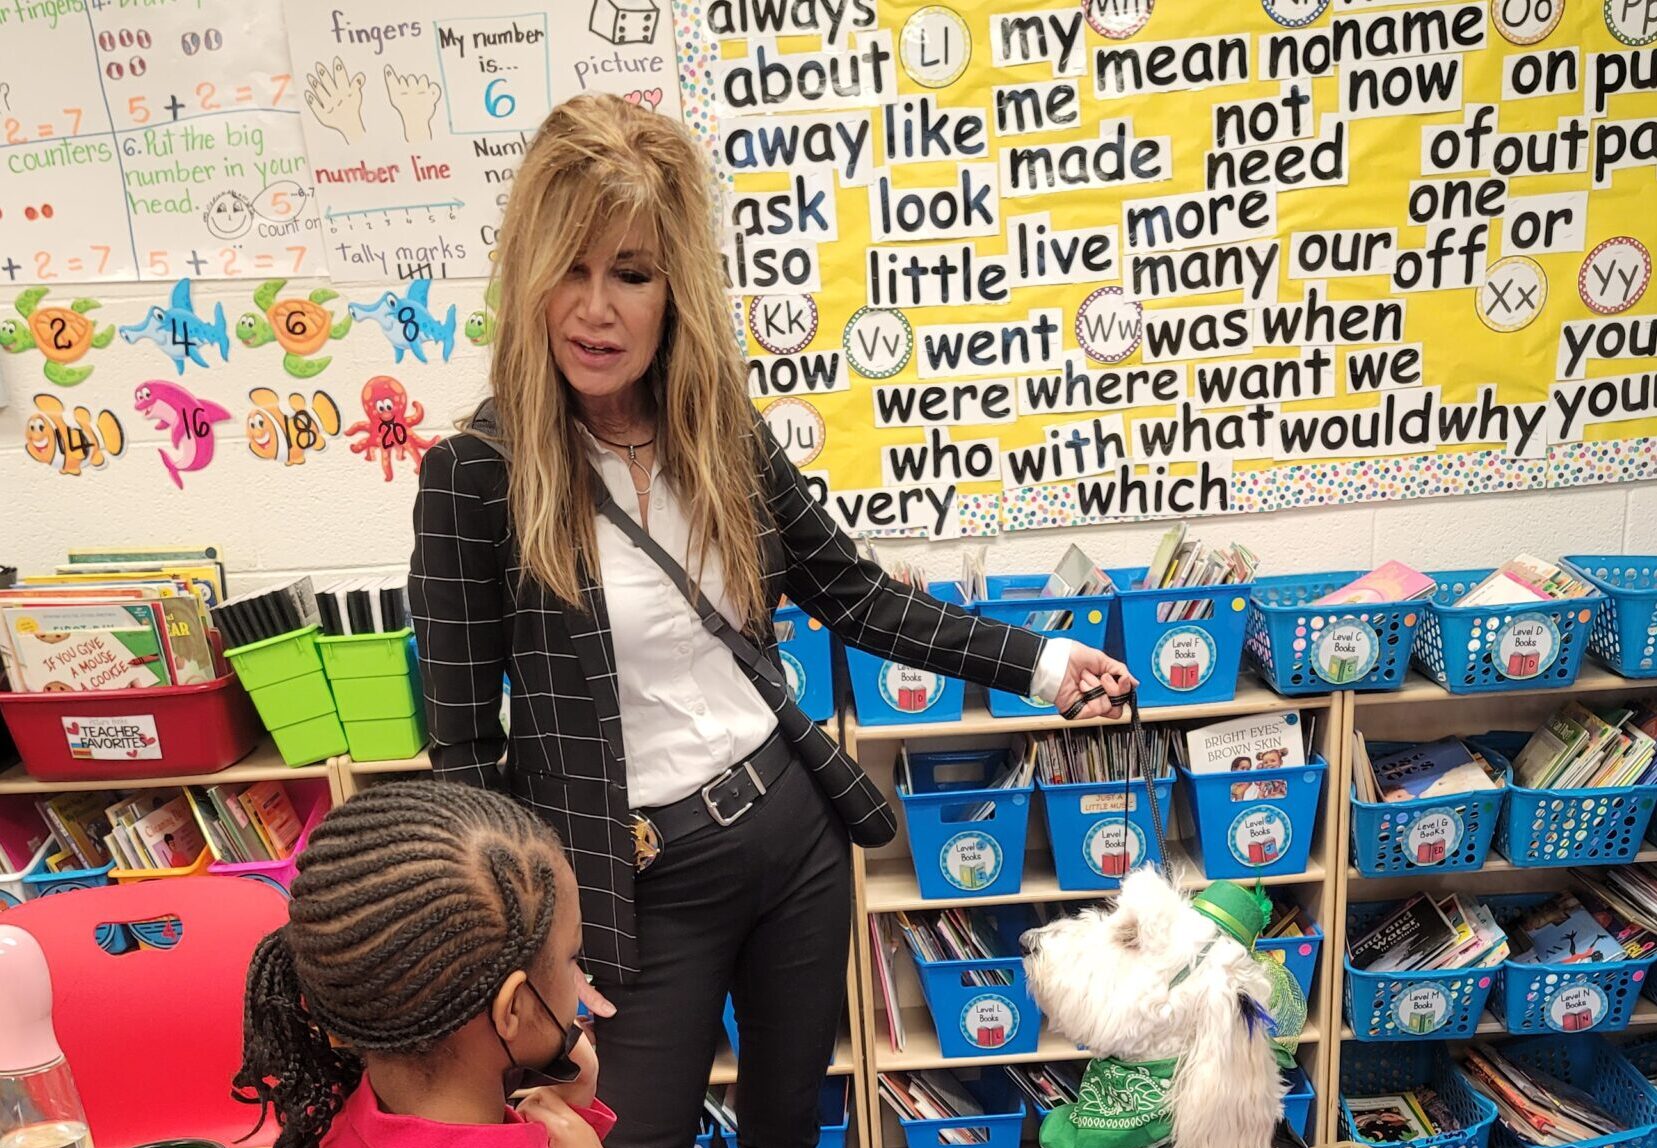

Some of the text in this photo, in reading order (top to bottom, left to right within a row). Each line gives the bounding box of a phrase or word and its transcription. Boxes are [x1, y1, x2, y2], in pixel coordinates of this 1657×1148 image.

[332, 10, 422, 54] fingers
[438, 23, 544, 58] My number
[707, 0, 876, 45] always
[1001, 12, 1083, 73] my
[1333, 6, 1484, 62] name
[574, 52, 664, 89] picture
[724, 41, 889, 107] about
[1097, 38, 1248, 93] mean
[1269, 35, 1330, 78] no
[1511, 49, 1577, 95] on
[128, 74, 291, 123] 5 2 7
[484, 78, 516, 118] 6
[1349, 59, 1458, 112] now
[5, 108, 83, 144] 2 7
[886, 98, 985, 159] like
[997, 85, 1078, 132] me
[1216, 84, 1310, 148] not
[8, 138, 112, 174] counters
[144, 127, 174, 158] Put
[183, 123, 215, 152] the
[226, 122, 264, 156] big
[725, 119, 869, 179] away
[1010, 123, 1162, 190] made
[1207, 121, 1343, 190] need
[1430, 105, 1494, 169] of
[1493, 119, 1588, 175] out
[125, 154, 306, 189] number in your
[314, 155, 452, 186] number line
[732, 174, 828, 236] ask
[880, 169, 994, 234] look
[1128, 190, 1270, 248] more
[1408, 179, 1505, 223] one
[395, 235, 466, 262] marks
[1510, 208, 1573, 249] or
[34, 245, 111, 280] 2 7
[286, 246, 307, 274] 7
[1018, 223, 1112, 279] live
[1132, 243, 1279, 300] many
[1299, 232, 1391, 273] our
[1393, 223, 1488, 289] off
[870, 246, 1008, 305] little
[50, 317, 74, 350] 2
[286, 311, 307, 336] 6
[398, 306, 420, 342] 8
[1146, 308, 1248, 358] was
[1263, 287, 1401, 344] when
[171, 318, 196, 357] 4
[925, 314, 1058, 371] went
[1026, 359, 1179, 410] where
[1198, 348, 1331, 403] want
[1348, 348, 1420, 391] we
[182, 407, 211, 439] 16
[877, 383, 1010, 424] were
[1279, 391, 1433, 453] would
[1439, 388, 1546, 457] why
[1554, 374, 1657, 440] you
[55, 427, 95, 461] 14
[284, 409, 318, 450] 18
[379, 420, 408, 450] 20
[1140, 402, 1274, 457] what
[890, 428, 992, 481] who
[1008, 418, 1125, 485] with
[1078, 461, 1228, 516] which
[837, 485, 955, 536] very
[56, 646, 77, 665] YOU
[77, 637, 105, 657] GIVE
[1172, 638, 1194, 650] Level
[1332, 631, 1355, 642] Level
[1334, 642, 1356, 653] Books
[1512, 626, 1543, 637] Level D
[1515, 637, 1537, 647] Books
[70, 650, 117, 679] A MOUSE
[90, 661, 129, 688] COOKIE
[1174, 649, 1196, 660] Books
[901, 672, 922, 682] Books
[80, 725, 141, 738] TEACHER
[80, 737, 147, 749] FAVORITES
[1204, 729, 1246, 749] BRIGHT
[1208, 737, 1282, 762] BROWN SKIN
[1250, 827, 1270, 837] Books
[1417, 819, 1438, 830] Level
[1371, 917, 1416, 950] Water
[1410, 990, 1429, 1001] Level
[1561, 990, 1580, 1002] Level
[979, 1014, 998, 1022] Books
